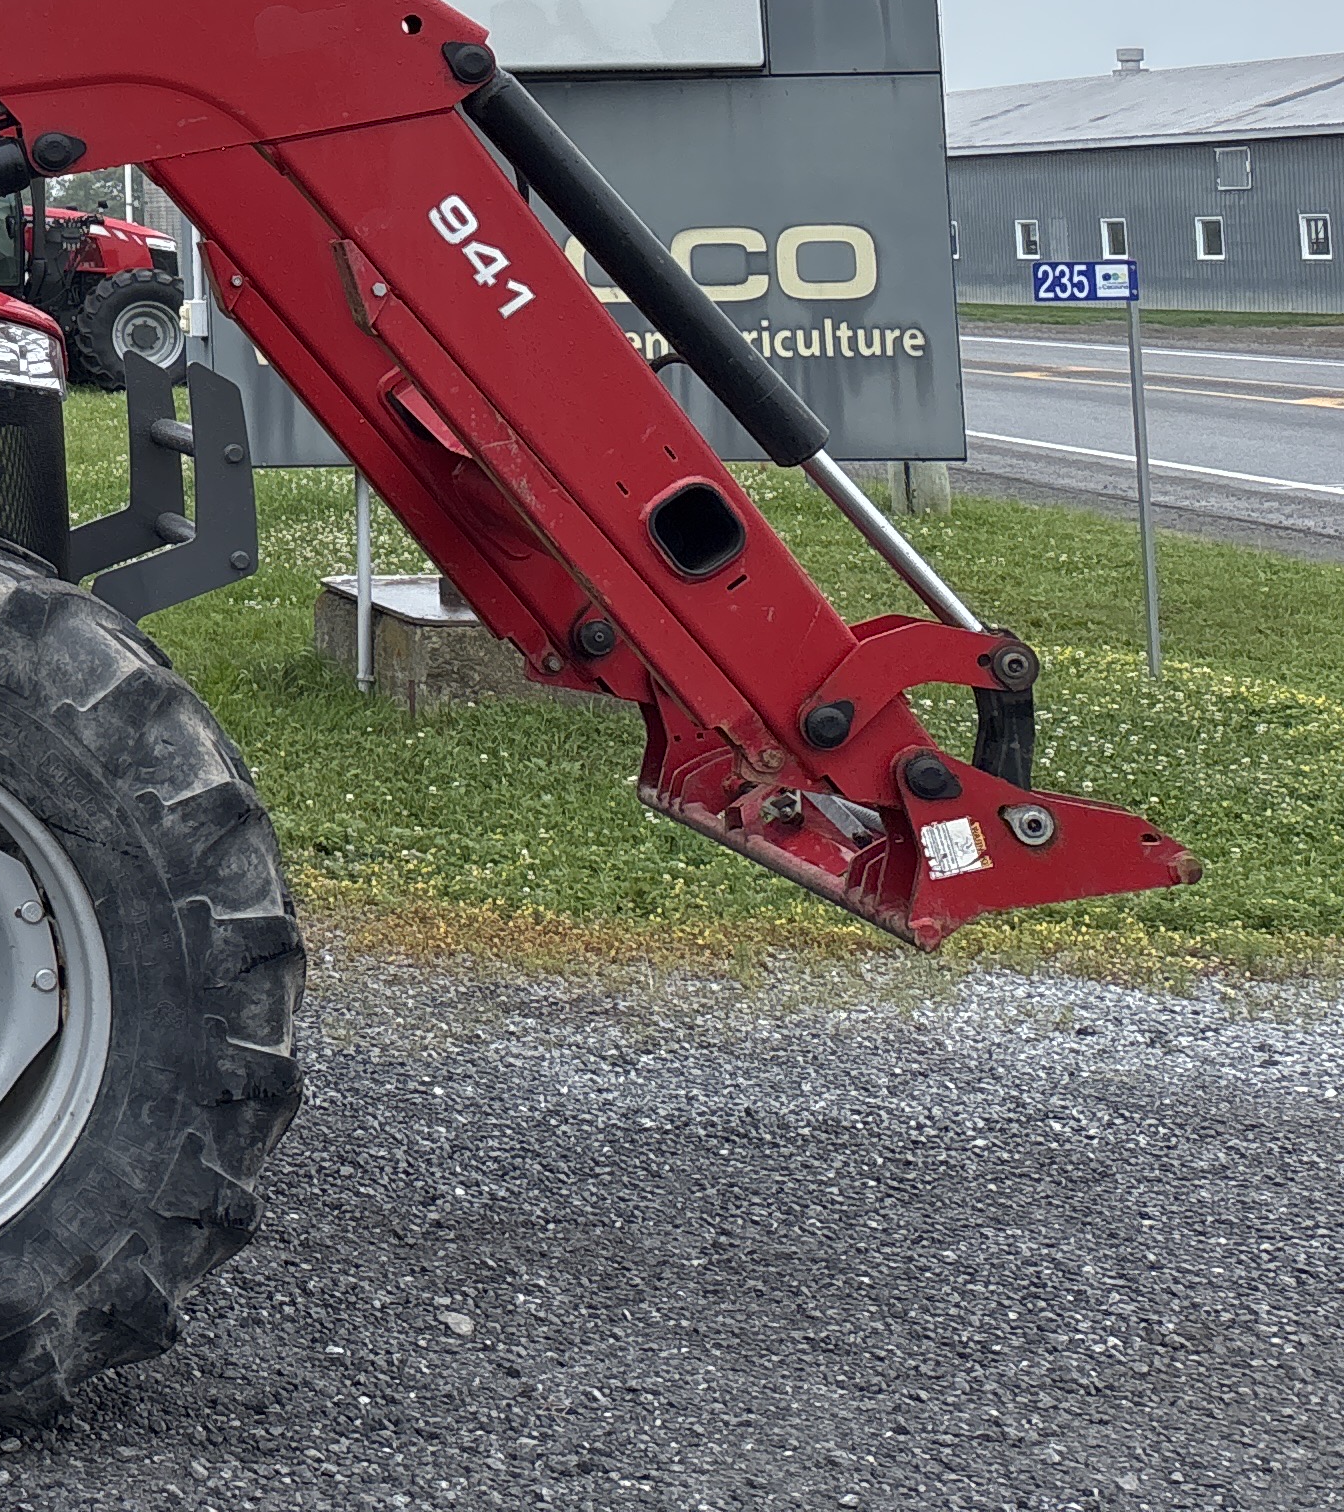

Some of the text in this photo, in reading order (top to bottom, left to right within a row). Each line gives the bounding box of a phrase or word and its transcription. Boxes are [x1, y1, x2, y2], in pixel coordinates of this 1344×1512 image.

[427, 193, 536, 320] 941
[564, 224, 878, 303] CO
[1037, 264, 1089, 299] 235
[742, 317, 926, 358] riculture
